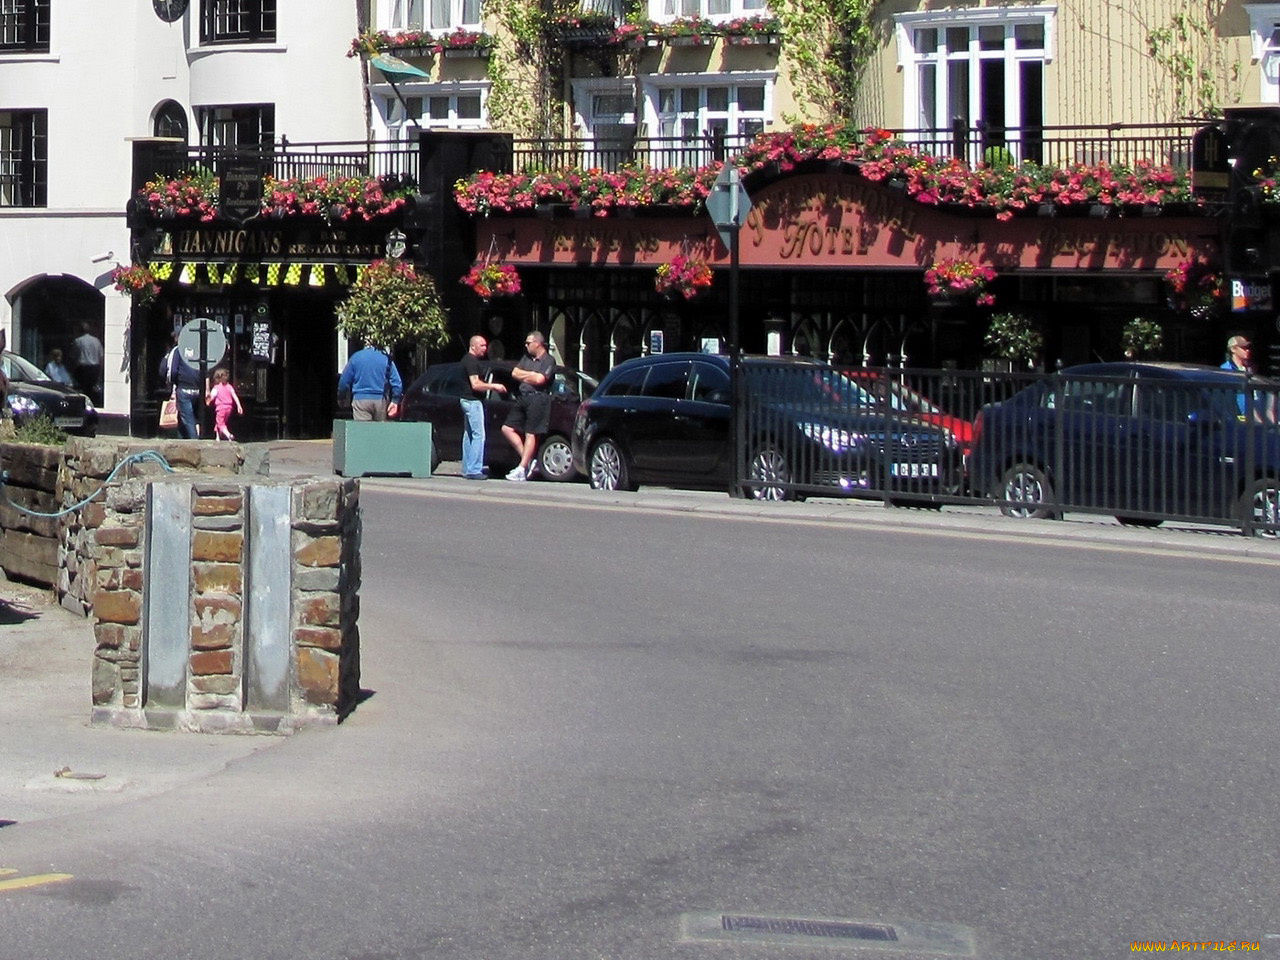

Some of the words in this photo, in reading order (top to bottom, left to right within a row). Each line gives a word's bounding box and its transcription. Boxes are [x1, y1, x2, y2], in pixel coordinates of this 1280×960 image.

[179, 230, 283, 254] HANNIGANS
[288, 243, 381, 255] RESTAURANT
[779, 218, 869, 259] HOTEL
[1232, 280, 1272, 301] Budget
